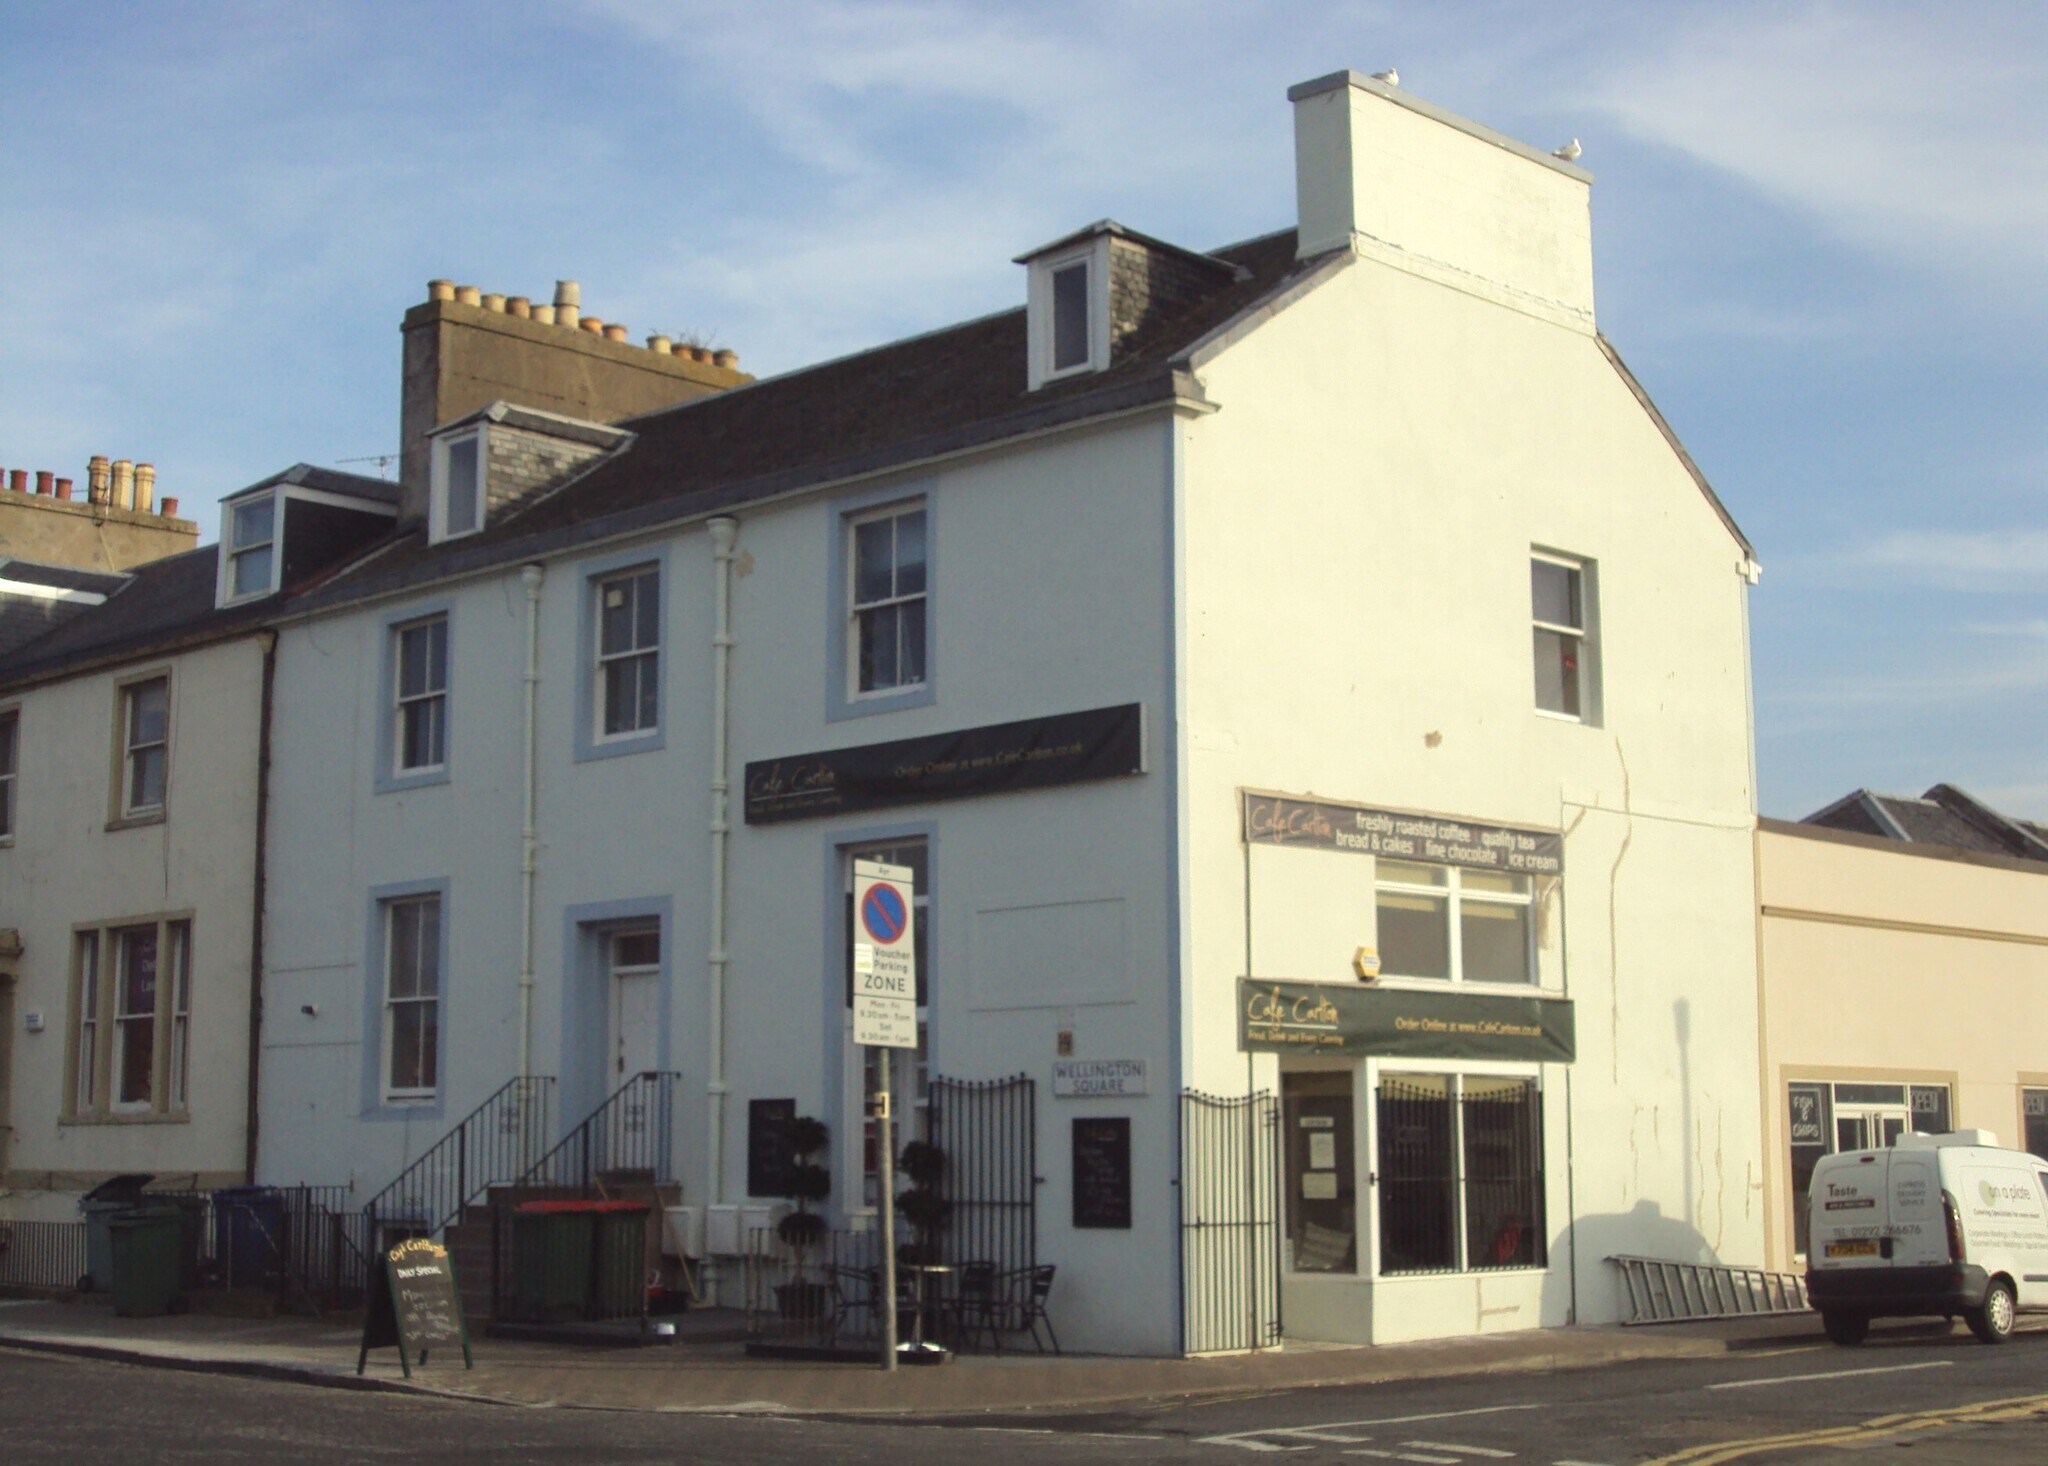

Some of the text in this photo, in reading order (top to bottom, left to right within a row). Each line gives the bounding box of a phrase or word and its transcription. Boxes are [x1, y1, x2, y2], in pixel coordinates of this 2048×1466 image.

[1356, 812, 1536, 850] freshly roasted coffee quality tea
[1336, 830, 1558, 871] bread & cakes fine chocolate ice cream
[873, 946, 911, 961] Voucher
[873, 959, 908, 974] Parking
[864, 974, 906, 992] ZONE
[1395, 1017, 1420, 1031] Order
[1421, 1018, 1447, 1032] Online
[1056, 1063, 1142, 1078] WELLINGTON
[1073, 1079, 1124, 1093] SQUARE
[1793, 1124, 1819, 1137] CHIPS
[1827, 1183, 1858, 1197] Taste
[2009, 1184, 2031, 1202] plate
